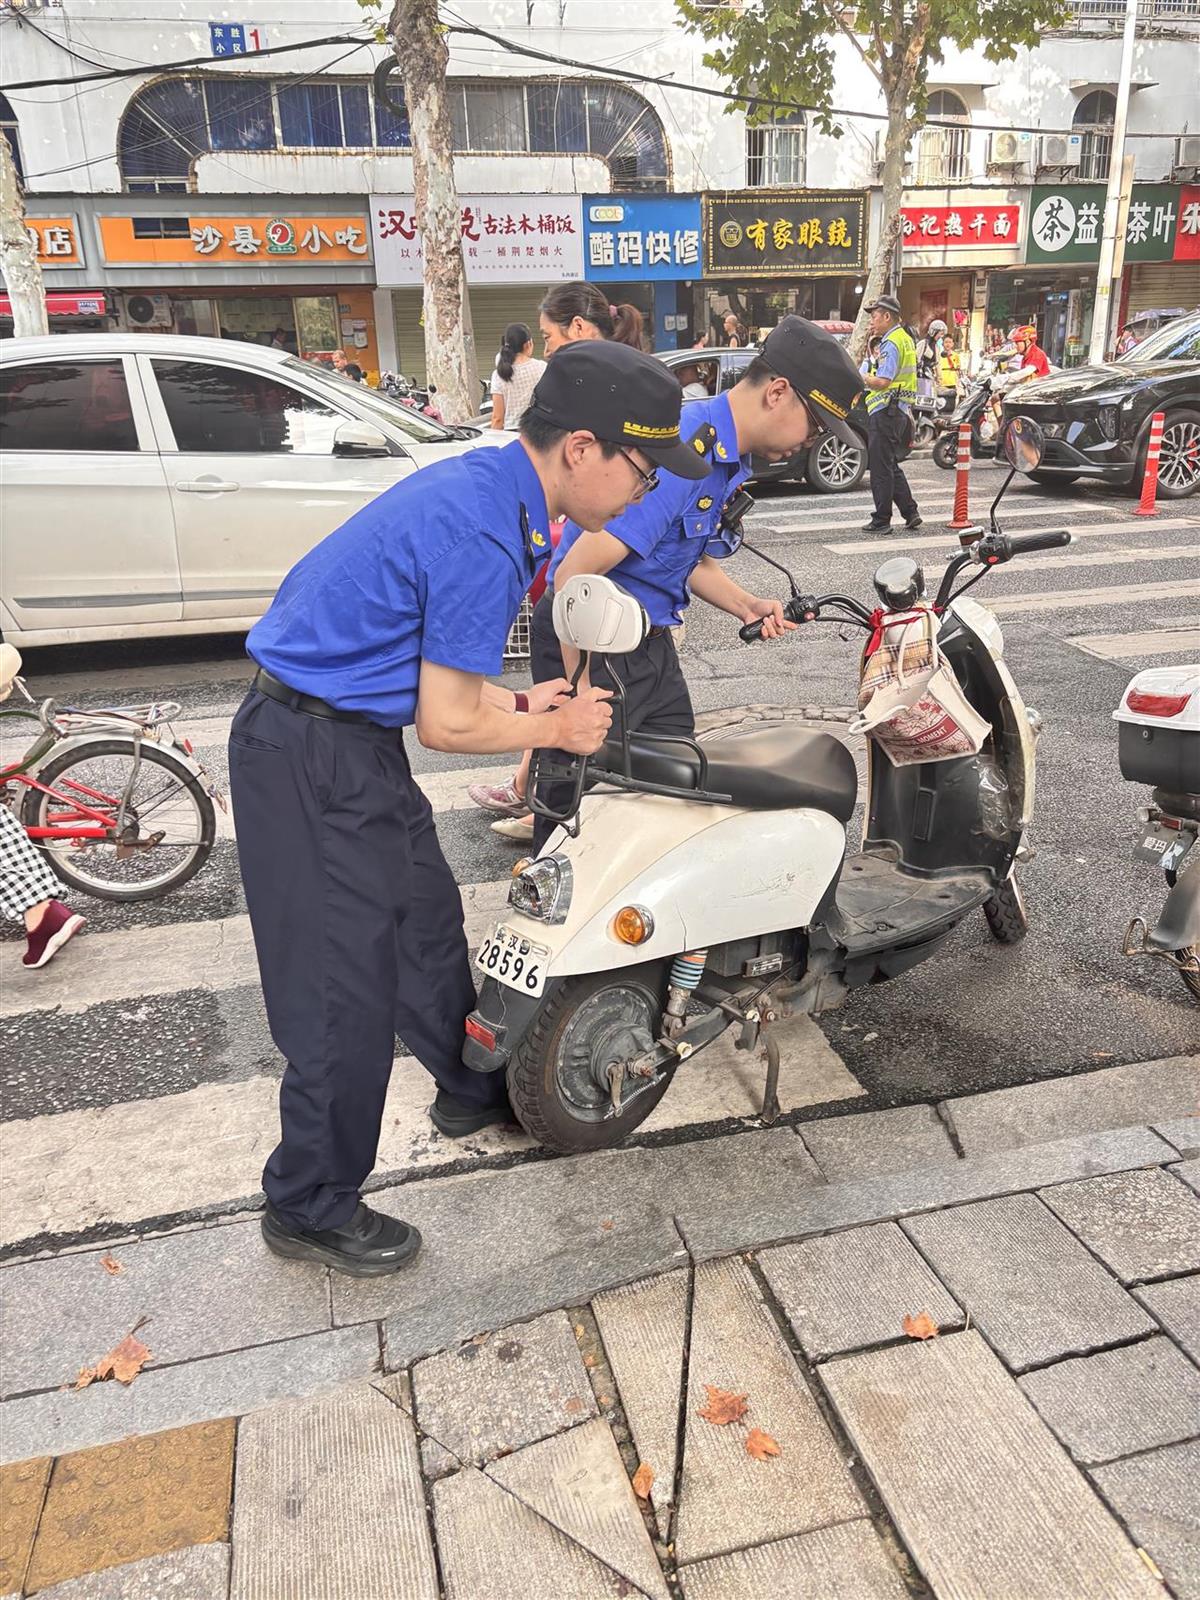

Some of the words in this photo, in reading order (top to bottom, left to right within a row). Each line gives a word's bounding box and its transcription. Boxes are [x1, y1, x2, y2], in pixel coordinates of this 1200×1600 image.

[249, 29, 260, 52] 1
[1036, 199, 1071, 243] 茶
[1074, 201, 1176, 245] 益茶叶
[589, 230, 699, 266] 酷码快修
[478, 939, 539, 989] 28596
